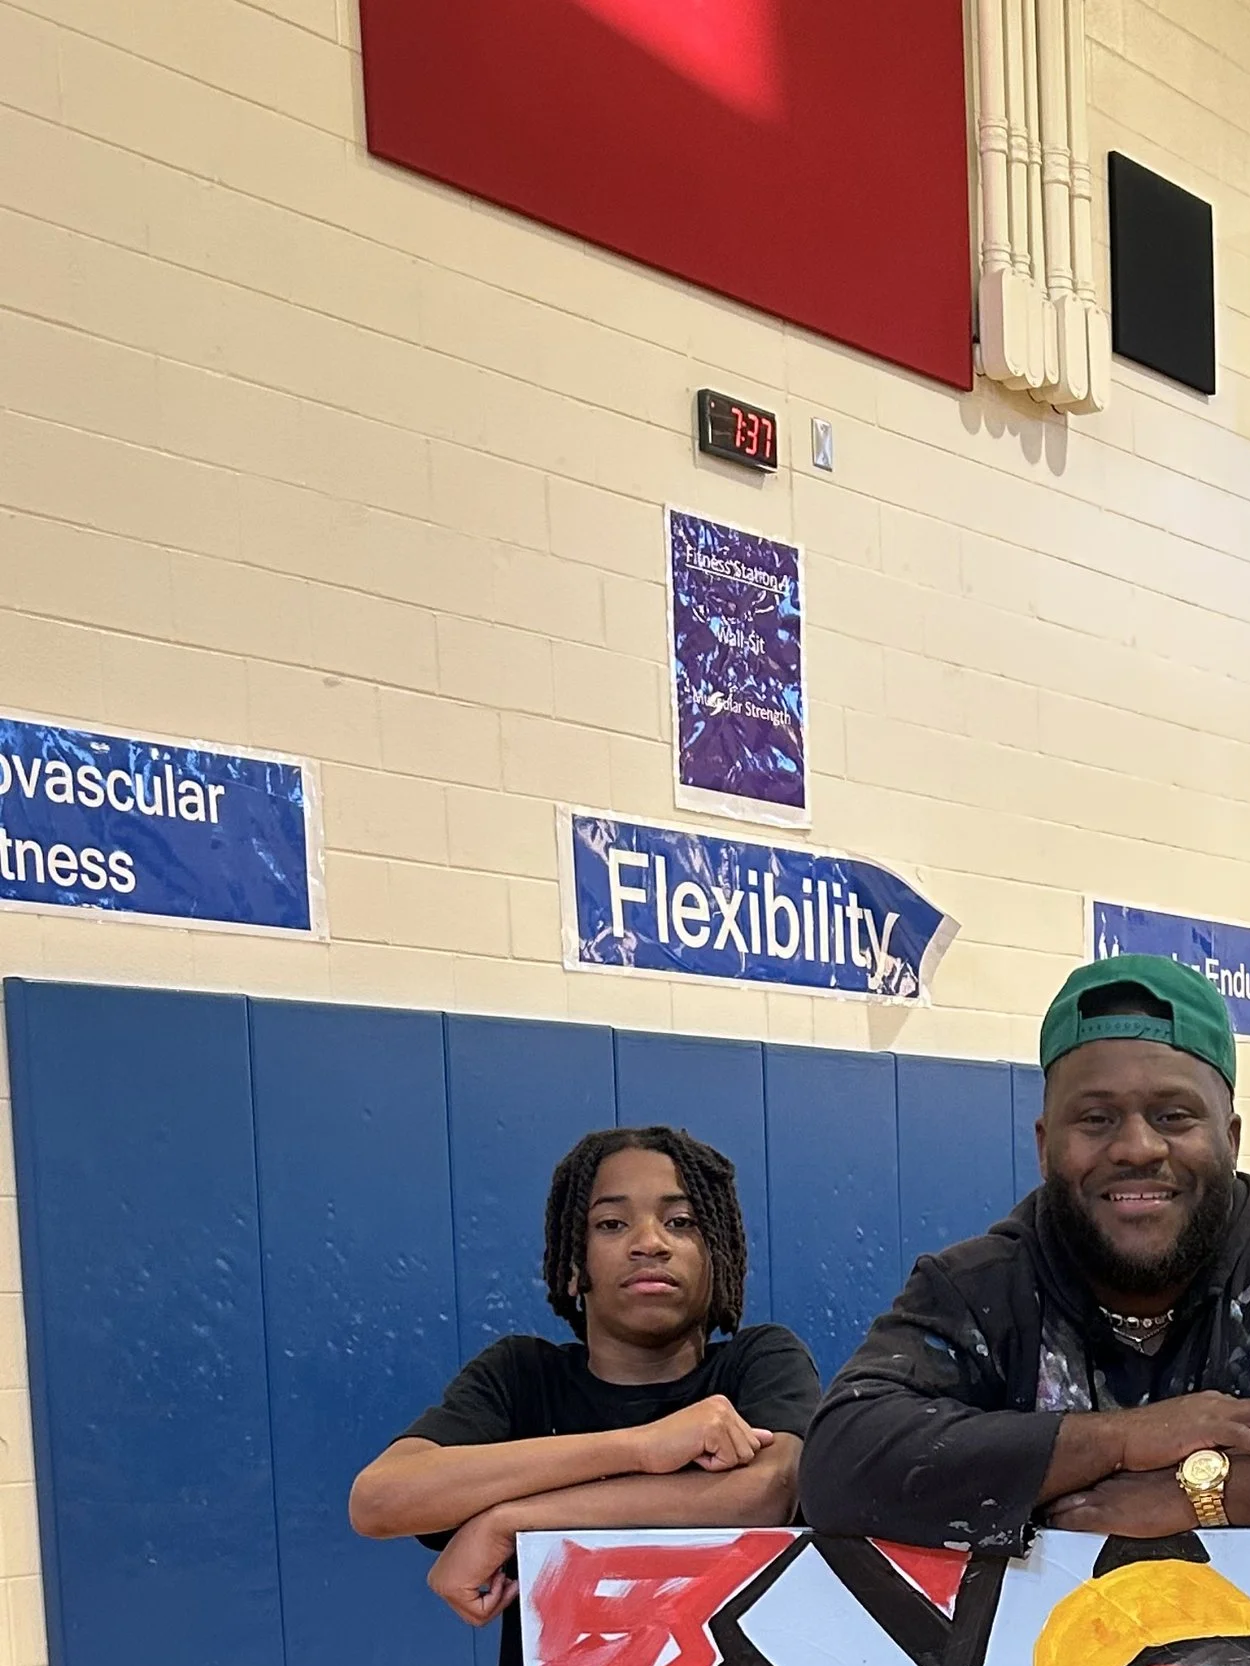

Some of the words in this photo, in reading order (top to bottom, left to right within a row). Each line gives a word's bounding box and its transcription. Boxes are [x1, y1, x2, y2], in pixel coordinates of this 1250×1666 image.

[731, 407, 771, 458] 7:37
[686, 547, 732, 575] Fitness
[733, 560, 778, 591] Station
[744, 701, 792, 727] Strength
[608, 847, 899, 992] Flexibility
